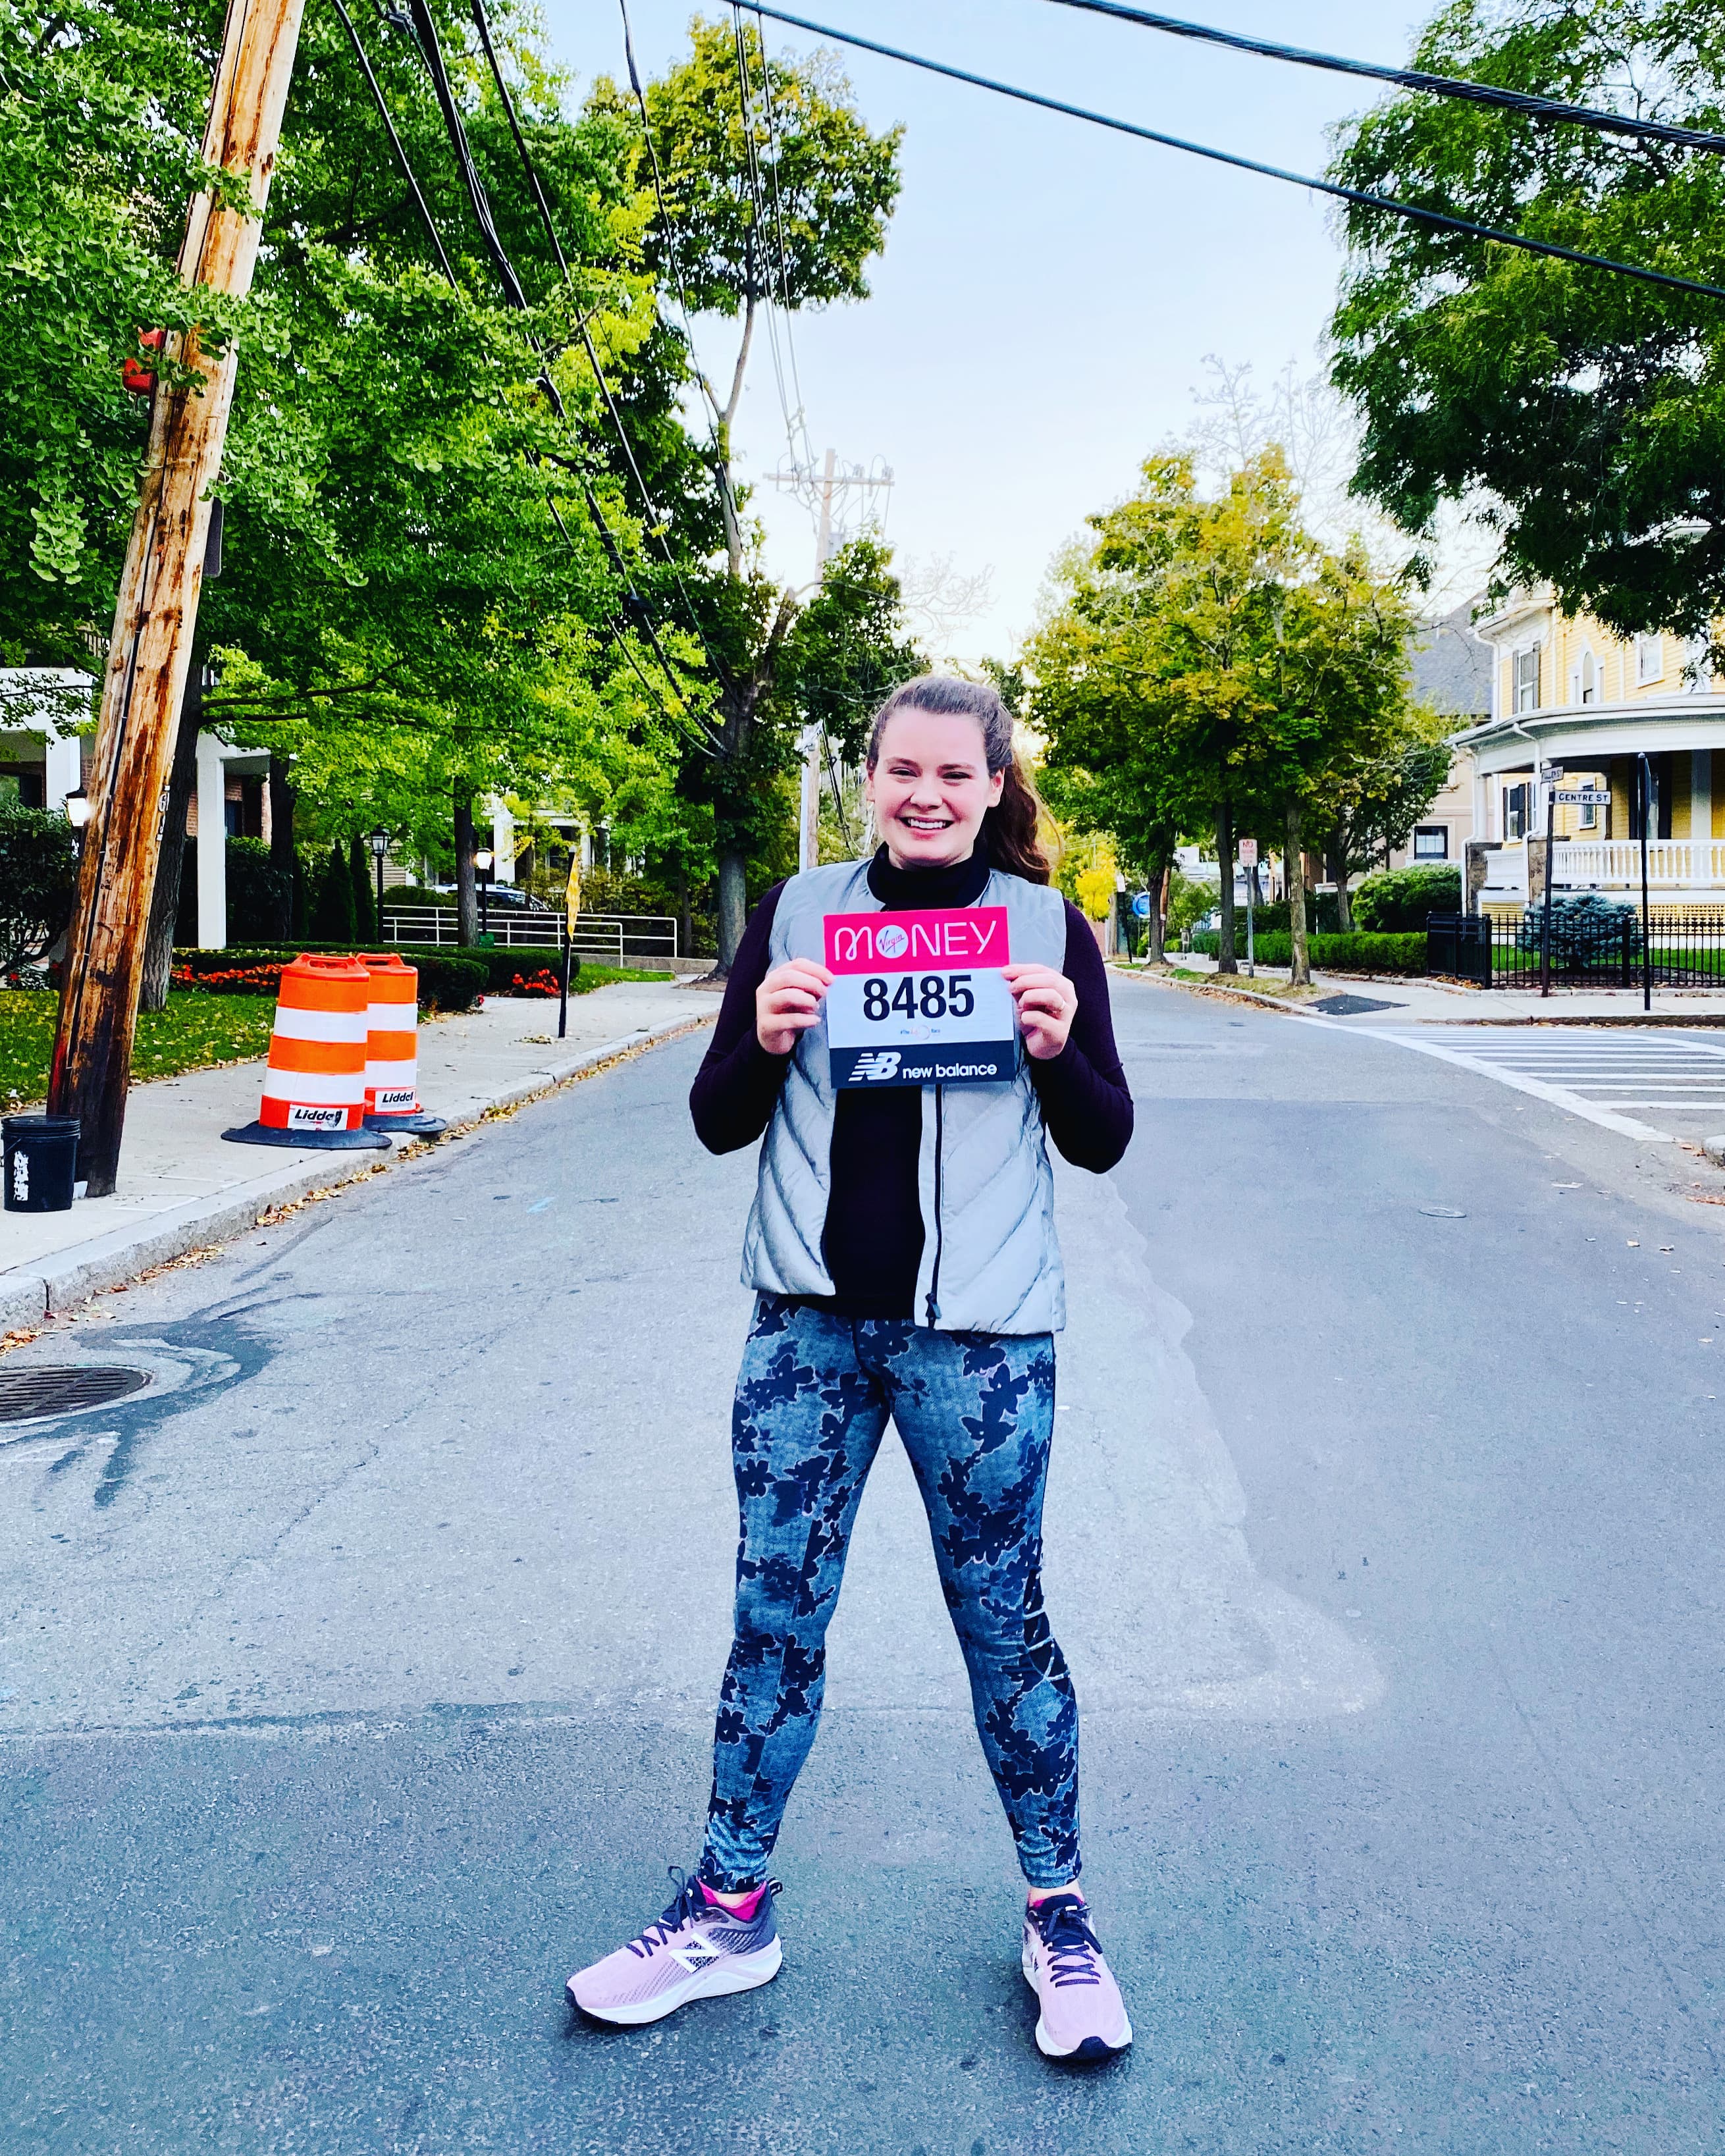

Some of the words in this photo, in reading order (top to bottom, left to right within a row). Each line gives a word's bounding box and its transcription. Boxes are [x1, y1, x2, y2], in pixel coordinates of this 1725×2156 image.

[1558, 793, 1593, 801] CENTRE
[1596, 793, 1608, 802] ST
[834, 920, 997, 961] MONEY
[880, 930, 905, 953] Virgin
[863, 974, 974, 1021] 8485
[903, 1066, 933, 1080] new
[936, 1063, 997, 1078] balance
